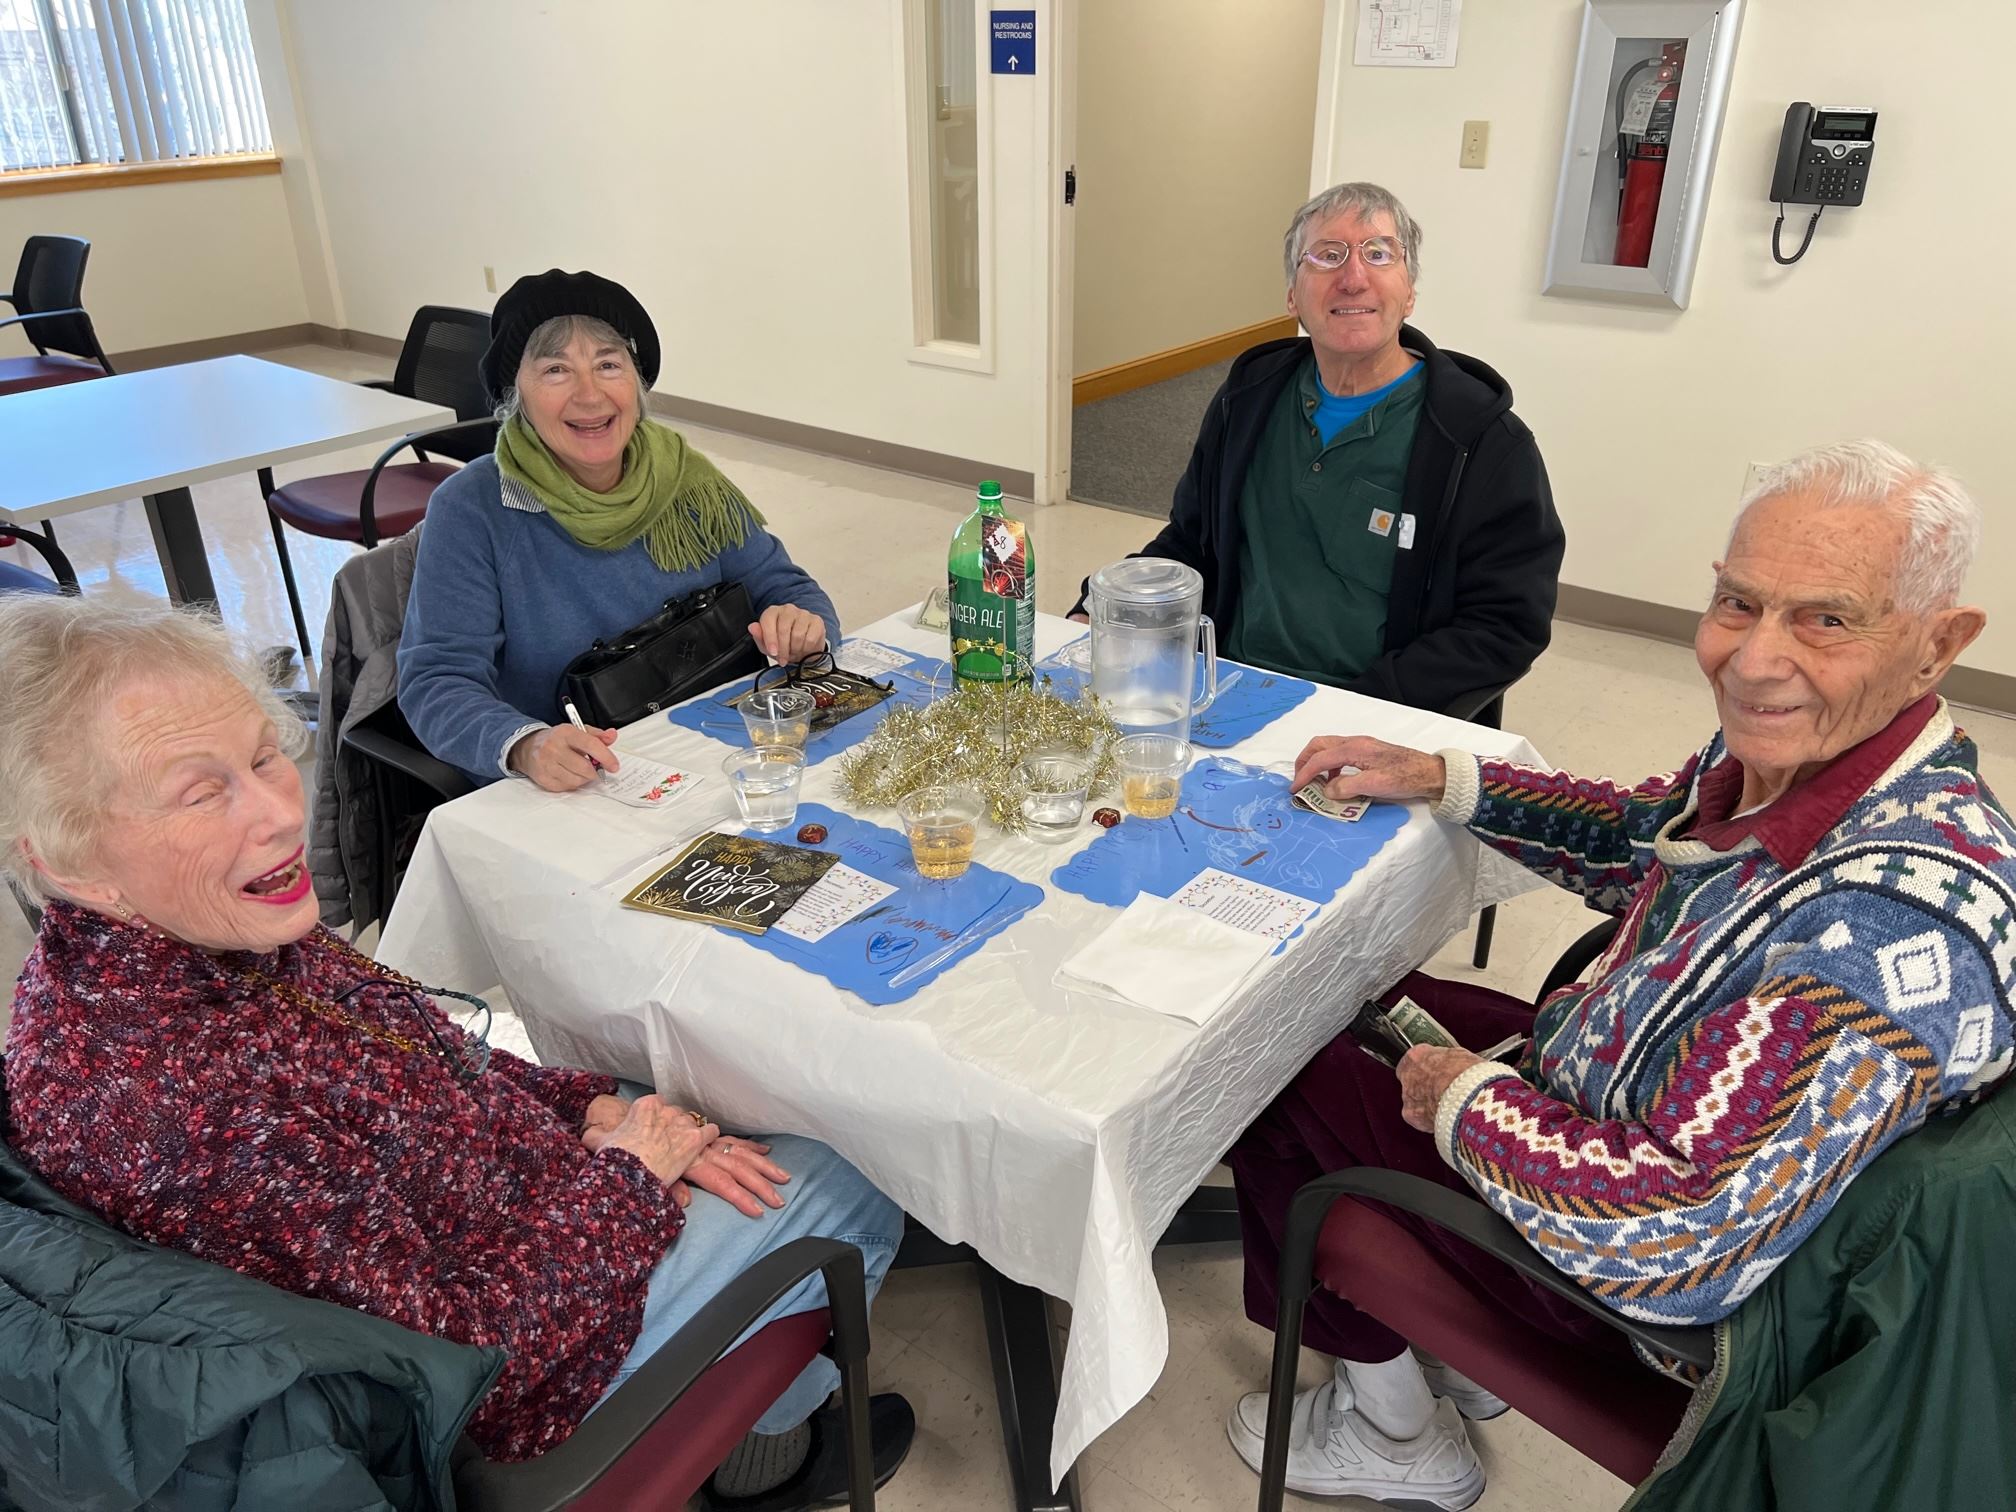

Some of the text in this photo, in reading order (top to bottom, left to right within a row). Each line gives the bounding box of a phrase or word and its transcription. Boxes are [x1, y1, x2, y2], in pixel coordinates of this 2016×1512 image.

[993, 22, 1034, 30] NURSING AND
[994, 31, 1032, 39] RESTROOMS
[950, 601, 1004, 629] NGER ALE
[1339, 806, 1362, 818] 5
[713, 851, 757, 866] HAPPY
[839, 838, 889, 865] HAPPY
[683, 859, 770, 901] New
[698, 876, 780, 917] Year
